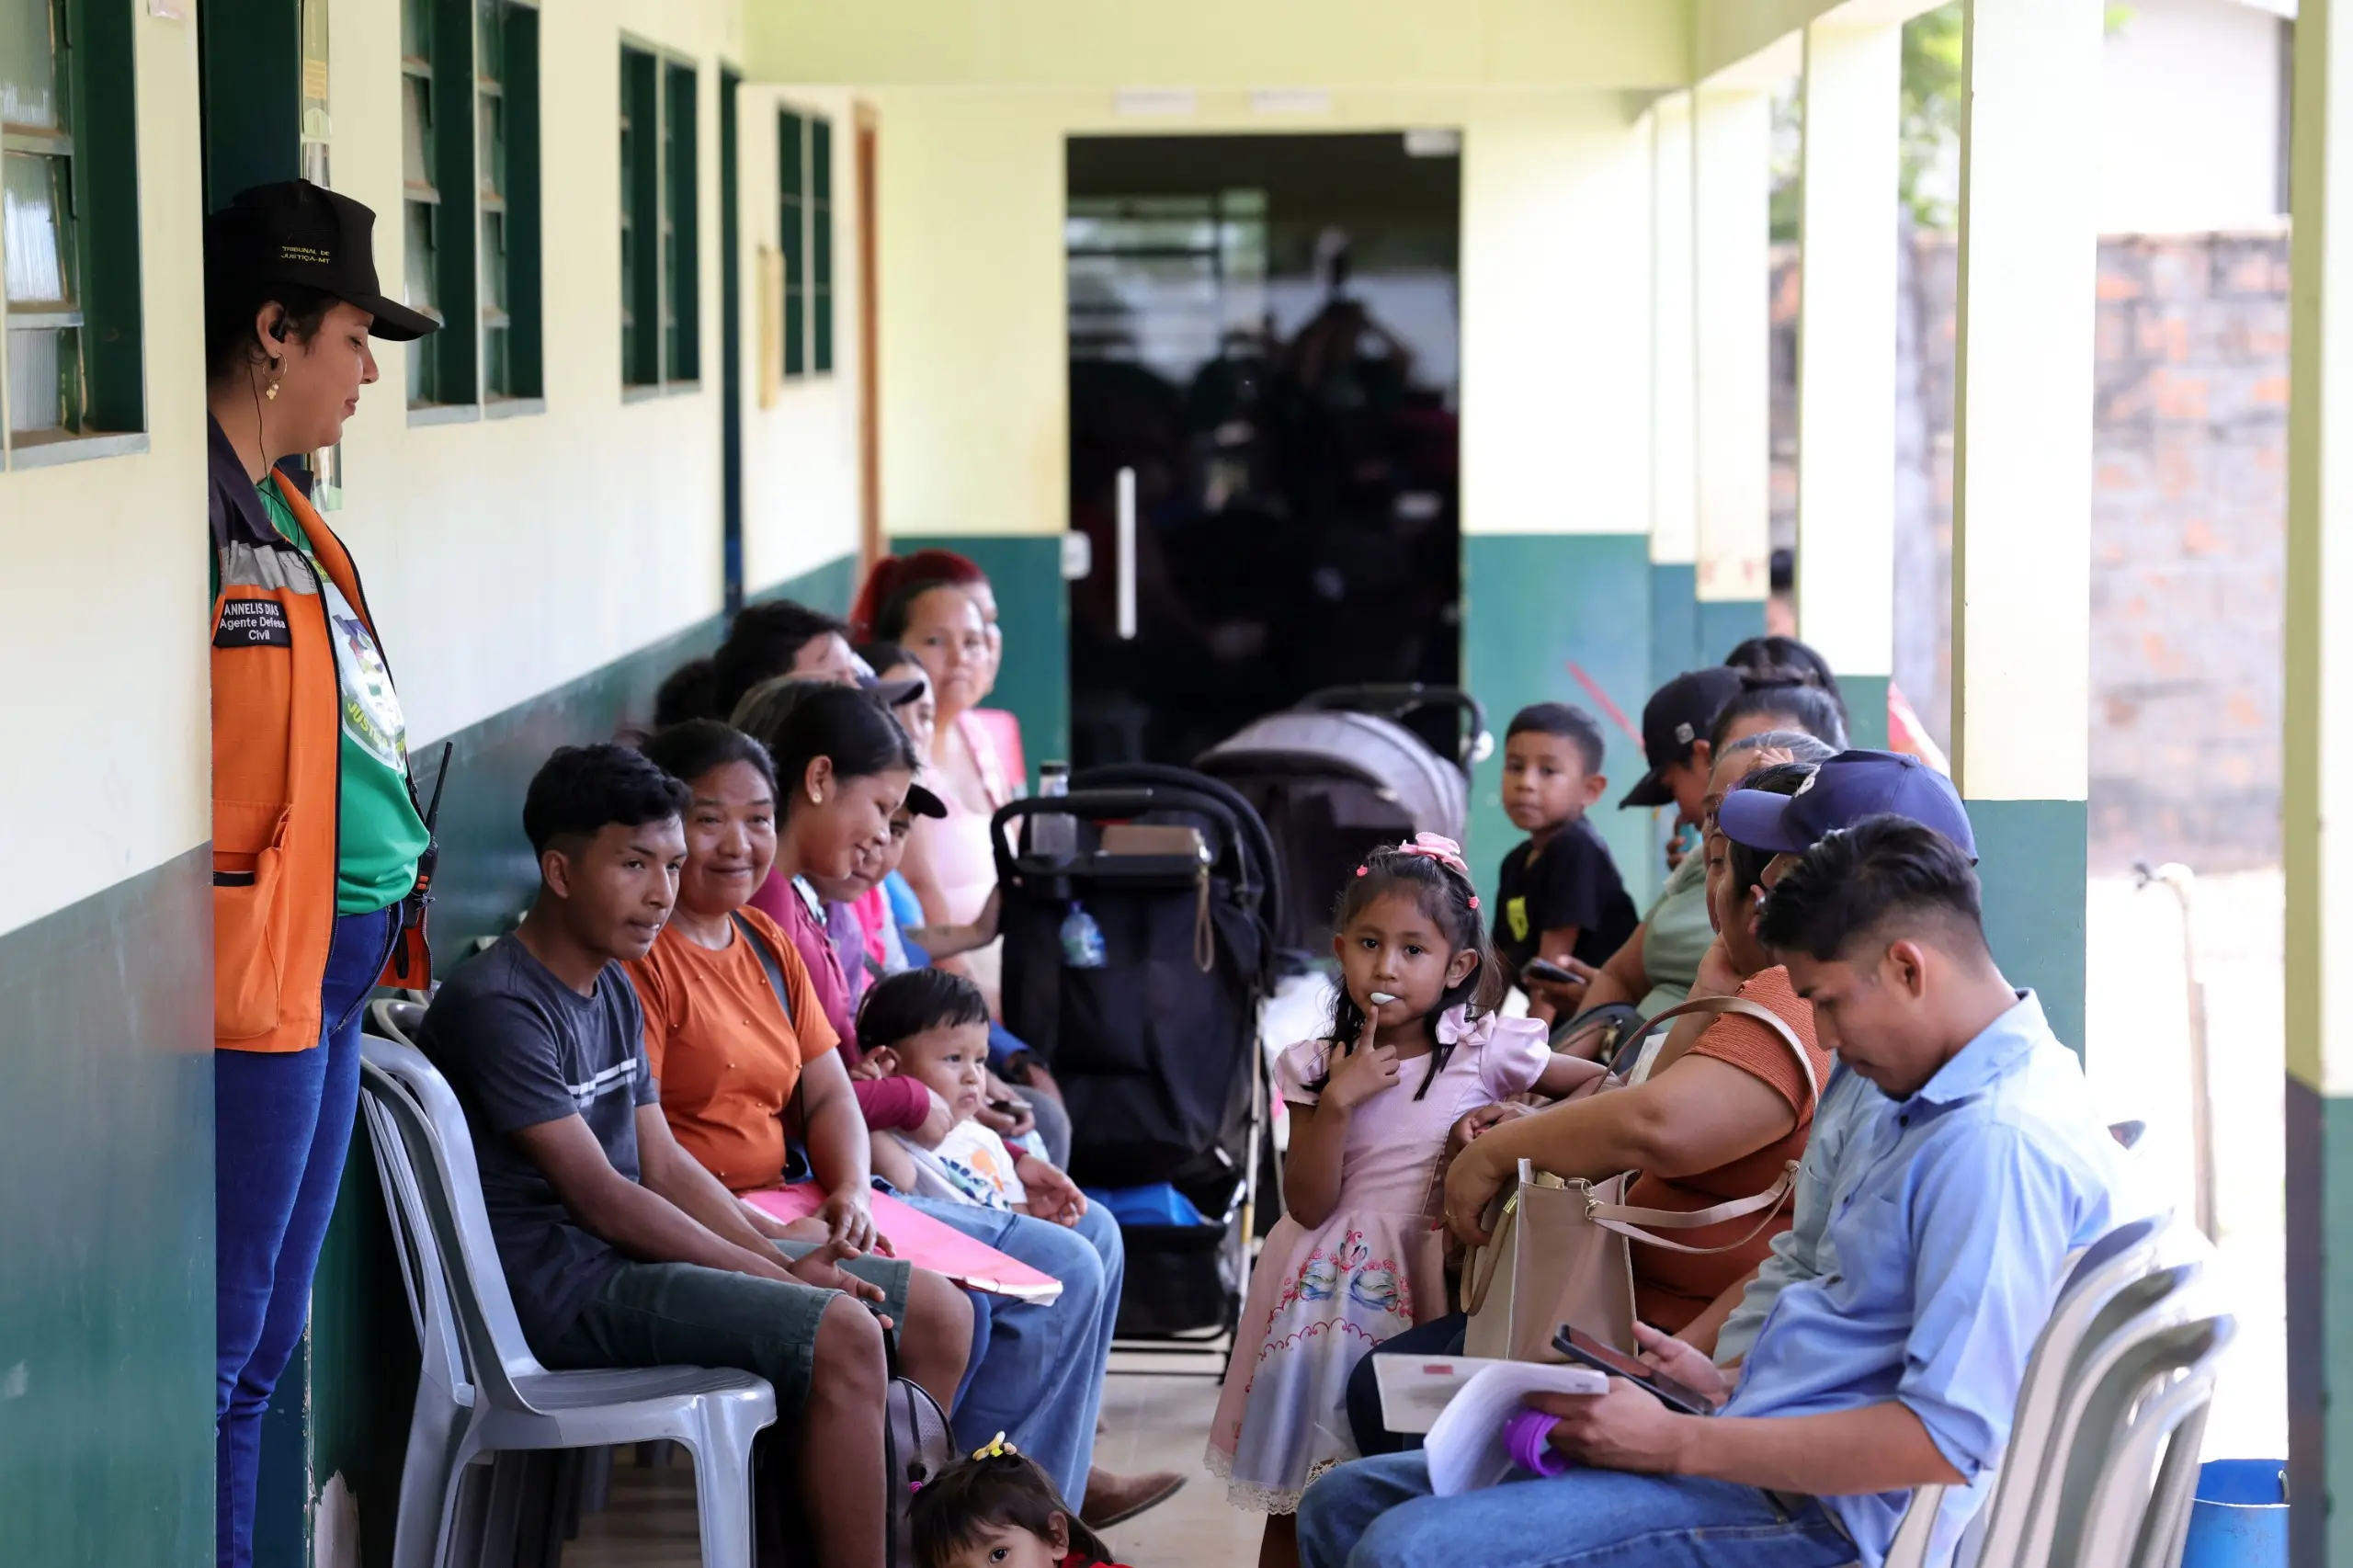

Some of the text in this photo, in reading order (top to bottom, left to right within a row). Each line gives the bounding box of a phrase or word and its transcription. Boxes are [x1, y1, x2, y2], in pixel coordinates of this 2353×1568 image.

[281, 245, 317, 255] TRIBUNAL
[280, 253, 331, 264] JUSTIÇA-MT
[224, 603, 279, 616] ANNELIS DIAS
[220, 616, 287, 631] Agente Defesa
[248, 630, 270, 640] Civil
